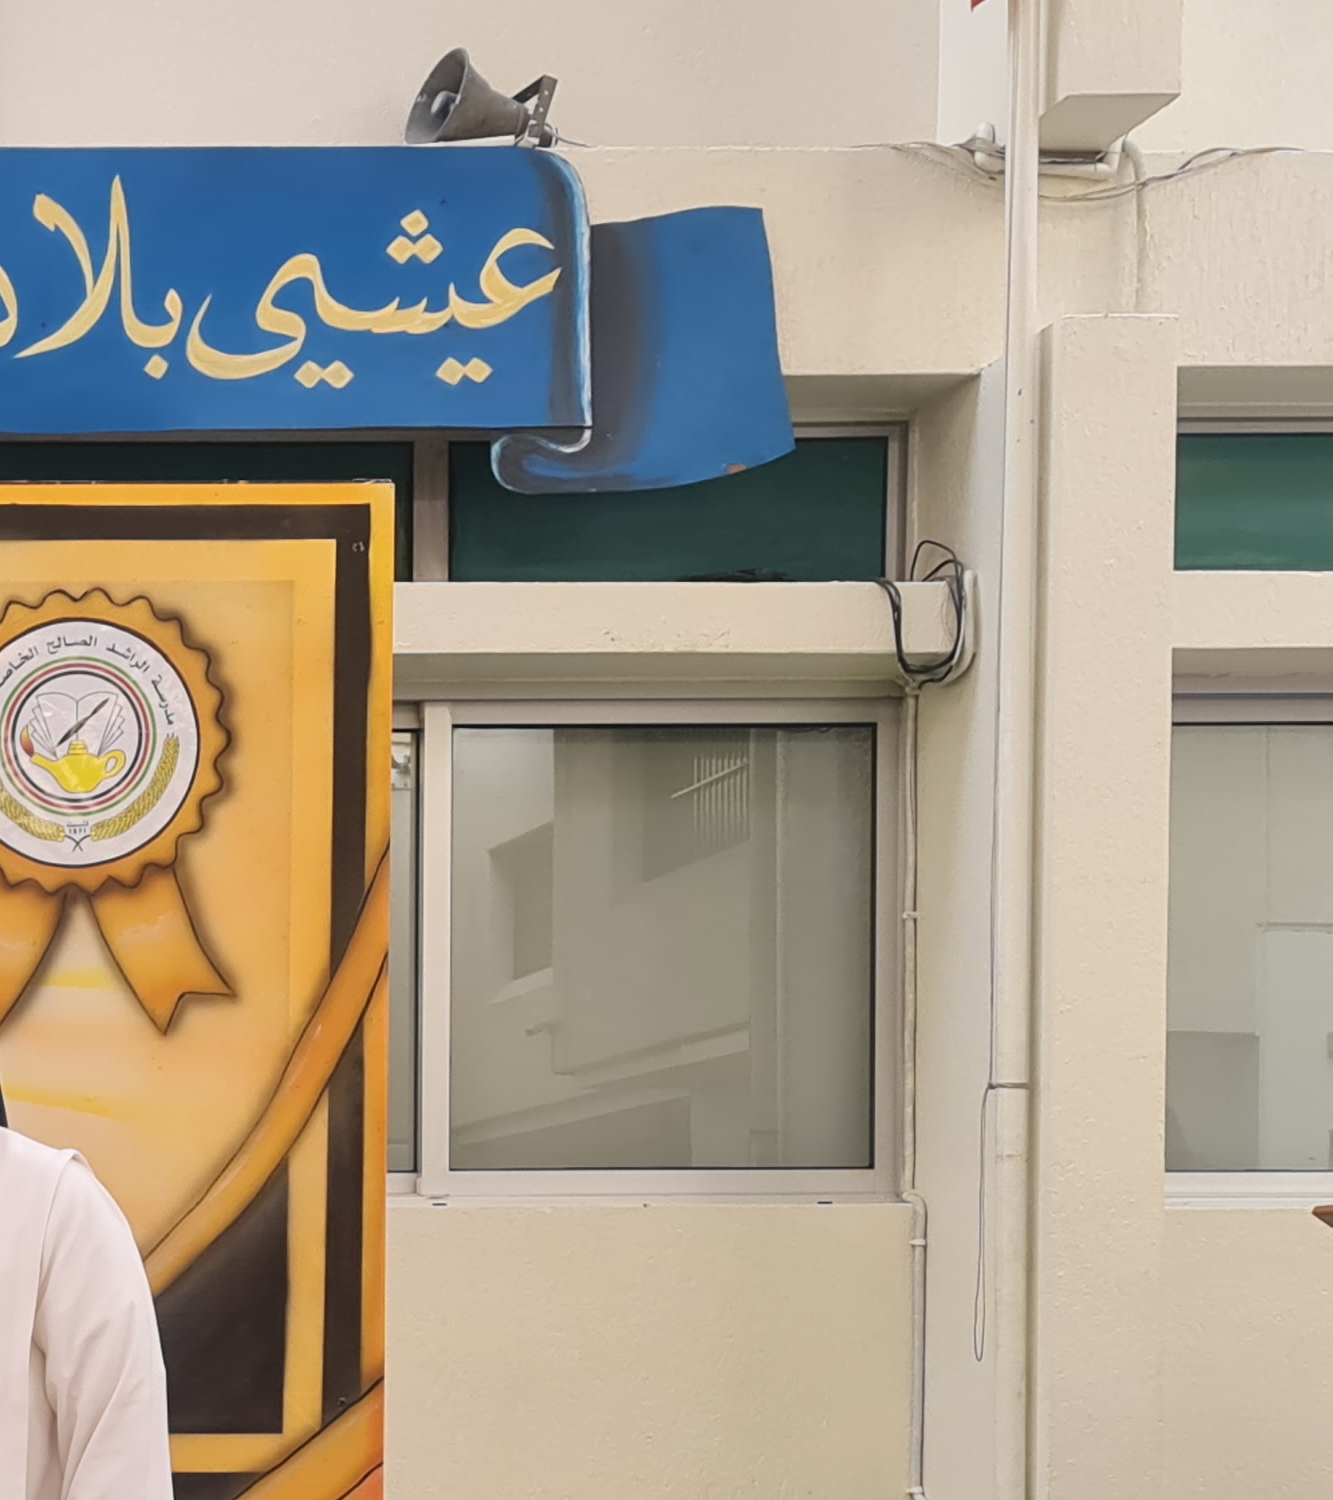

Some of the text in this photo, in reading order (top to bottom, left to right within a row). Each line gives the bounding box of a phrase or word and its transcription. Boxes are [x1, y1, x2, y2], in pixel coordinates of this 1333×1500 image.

[186, 209, 563, 389] عيشي
[46, 634, 98, 655] الصالح
[105, 642, 151, 673] الراشد
[150, 673, 175, 726] مدرسة
